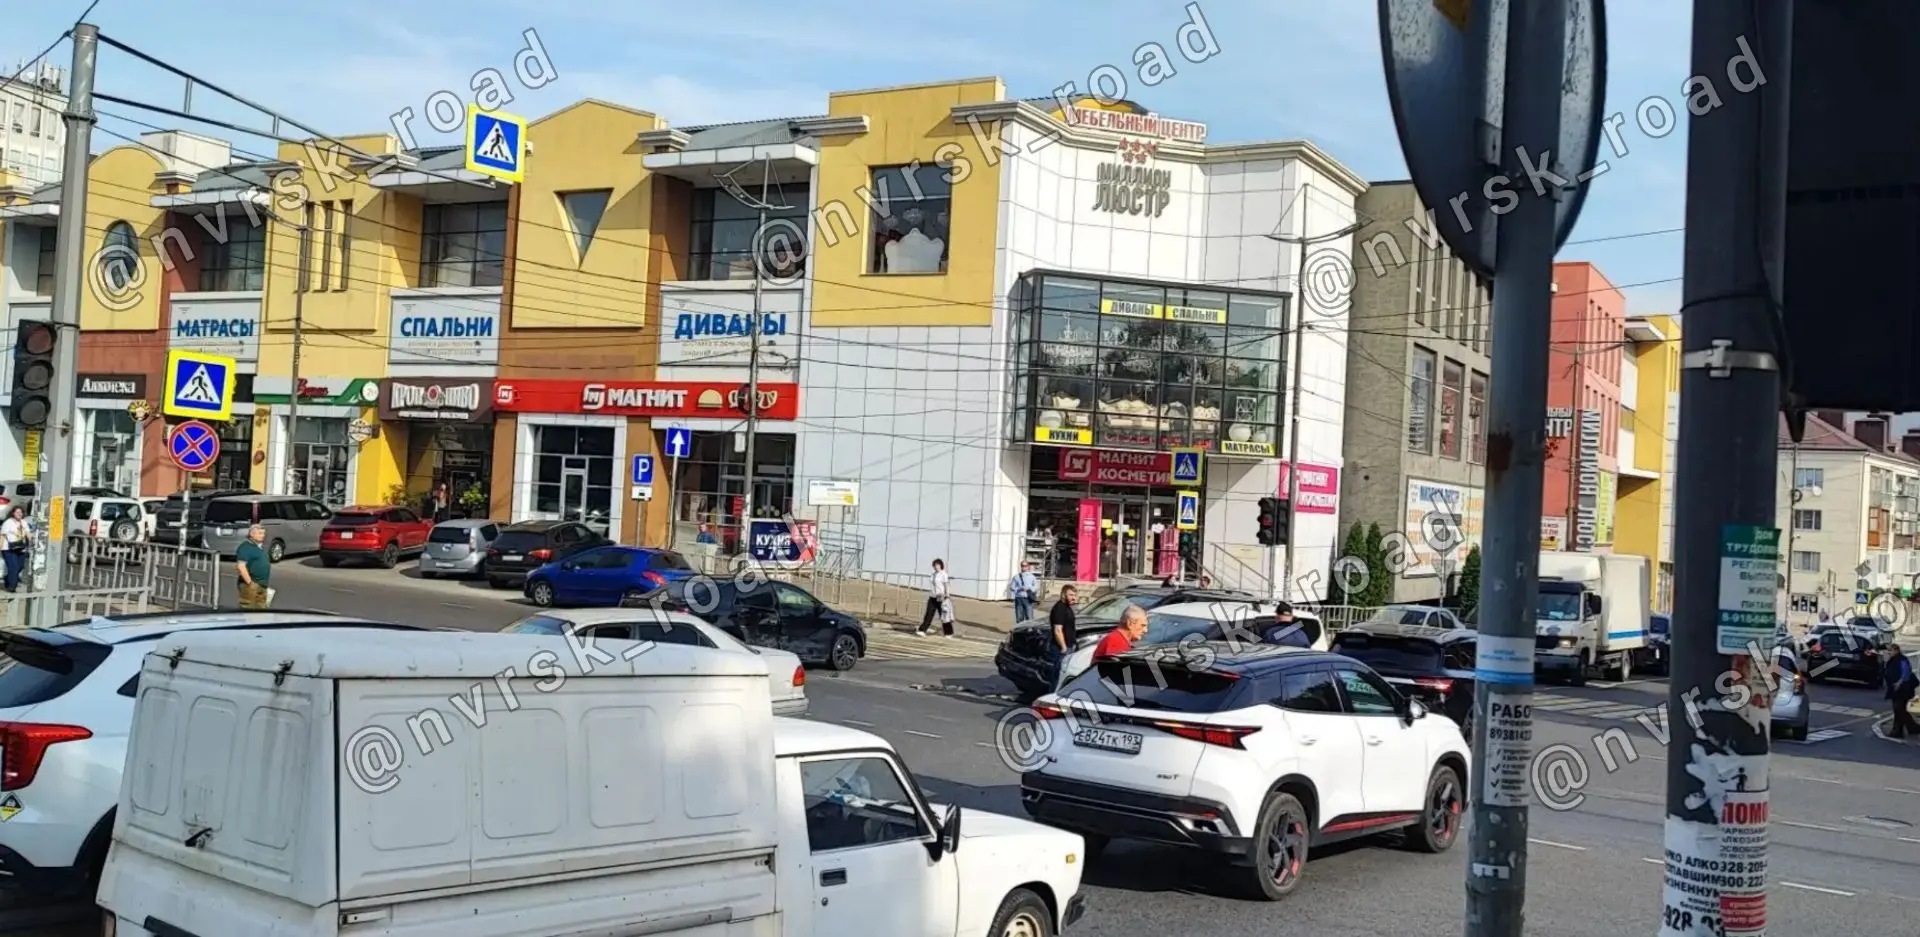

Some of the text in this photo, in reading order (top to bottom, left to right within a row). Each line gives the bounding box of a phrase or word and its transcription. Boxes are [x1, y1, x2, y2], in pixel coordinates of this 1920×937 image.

[1067, 105, 1206, 140] МЕБЕЛЬНЫЙ ЦЕНТР
[1097, 162, 1171, 188] МИЛЛИОН
[1093, 183, 1171, 217] ЛЮСТР
[1110, 300, 1155, 315] ДИВАНЫ
[177, 319, 254, 337] МАТРАСЫ
[400, 316, 493, 337] СПАЛЬНИ
[674, 313, 786, 339] ДИВАНЫ
[607, 387, 688, 408] МАГНИТ
[1224, 441, 1270, 454] МАТРАСЫ
[1098, 451, 1156, 466] МАГНИТ
[1575, 408, 1601, 551] МИЛЛИОН ЛЮС
